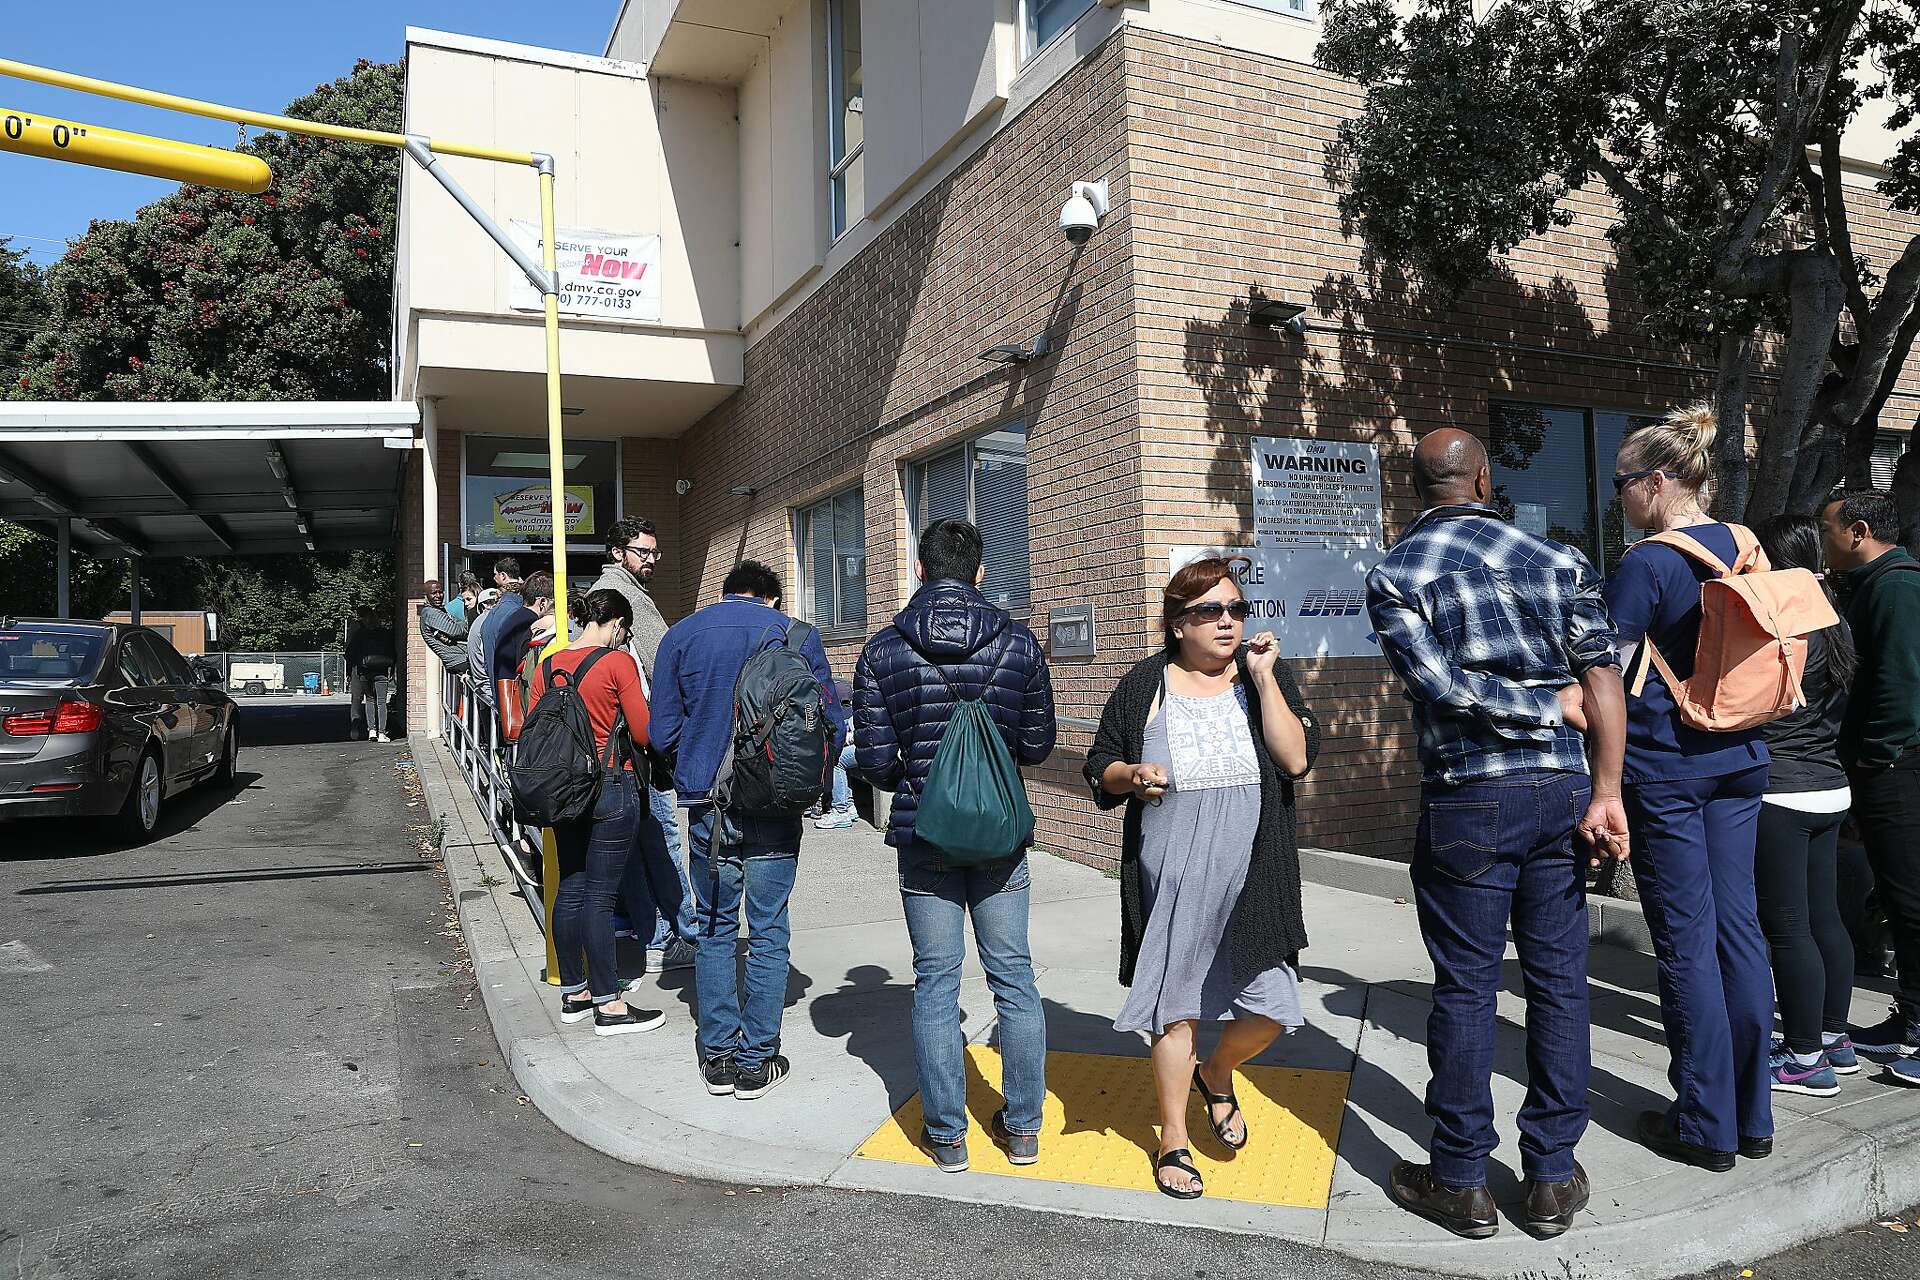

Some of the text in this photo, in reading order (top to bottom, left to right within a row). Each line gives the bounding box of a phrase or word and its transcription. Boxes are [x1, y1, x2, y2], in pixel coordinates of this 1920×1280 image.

[537, 239, 628, 257] RSERVE YOUR
[560, 282, 642, 299] .dmv.ca.gov
[576, 294, 632, 310] 777-0133
[1263, 453, 1367, 474] WARNING
[1257, 480, 1287, 488] PERSONS
[1311, 483, 1340, 491] VEHICLES
[1340, 484, 1374, 492] PERMITTED
[1289, 473, 1344, 483] NO UNAUTHORIZED
[540, 501, 585, 514] NW
[1258, 516, 1267, 524] NO
[1231, 566, 1265, 585] ICLE
[1245, 599, 1286, 618] ATION
